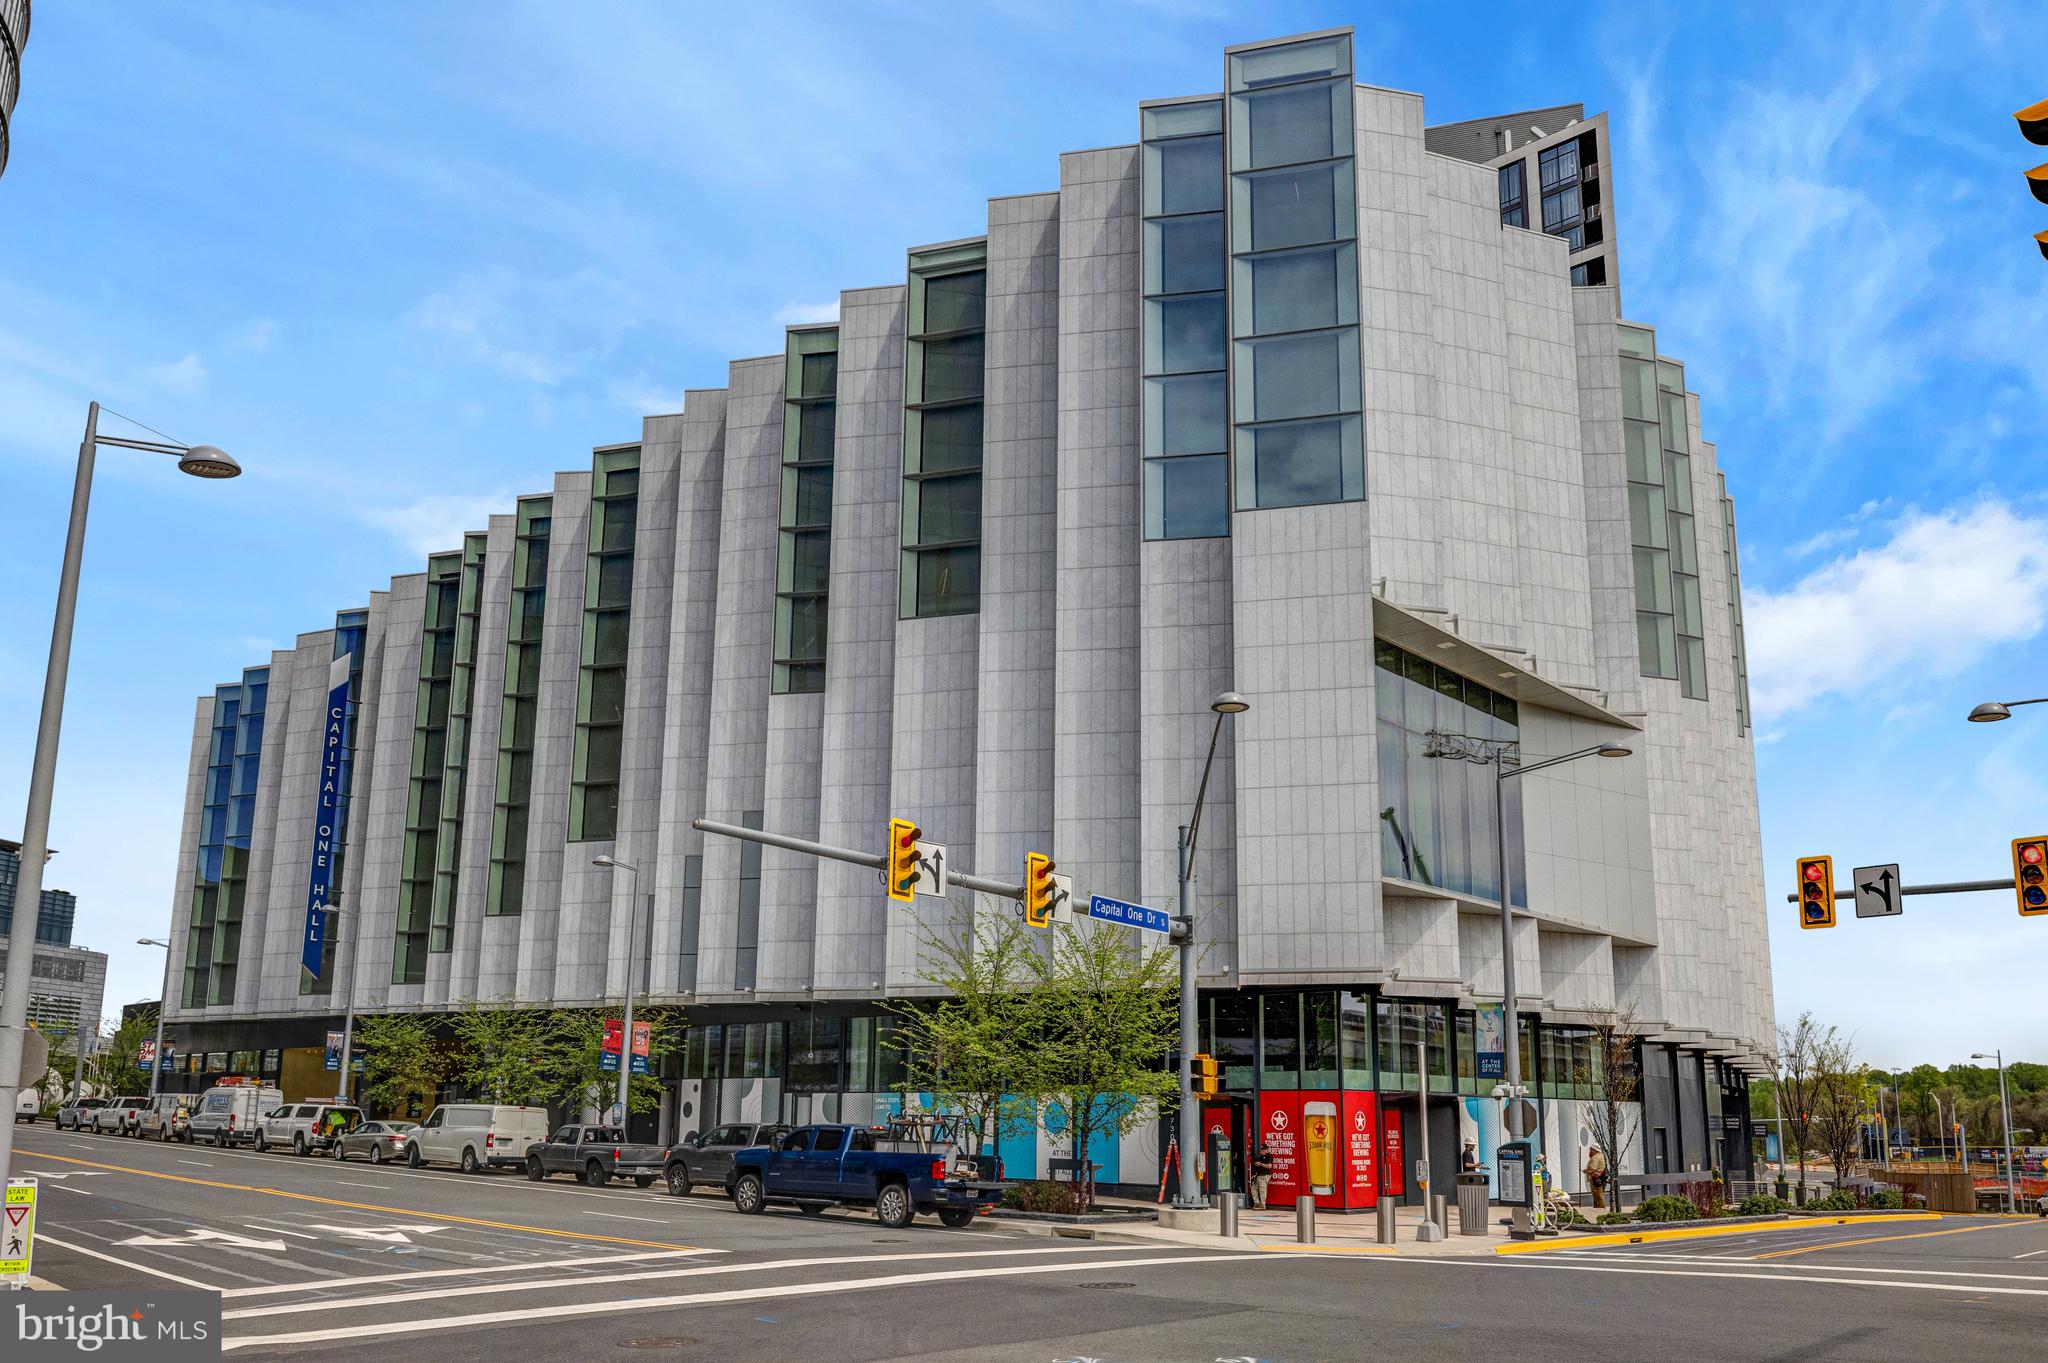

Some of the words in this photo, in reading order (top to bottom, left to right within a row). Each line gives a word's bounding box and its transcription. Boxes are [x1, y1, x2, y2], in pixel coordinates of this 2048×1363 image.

[323, 707, 342, 807] CAPITAL
[317, 825, 331, 867] ONE
[310, 884, 325, 942] HALL
[1095, 900, 1123, 917] Capital
[1127, 908, 1143, 922] One
[1147, 911, 1156, 925] Dr
[1309, 1141, 1322, 1150] STARR
